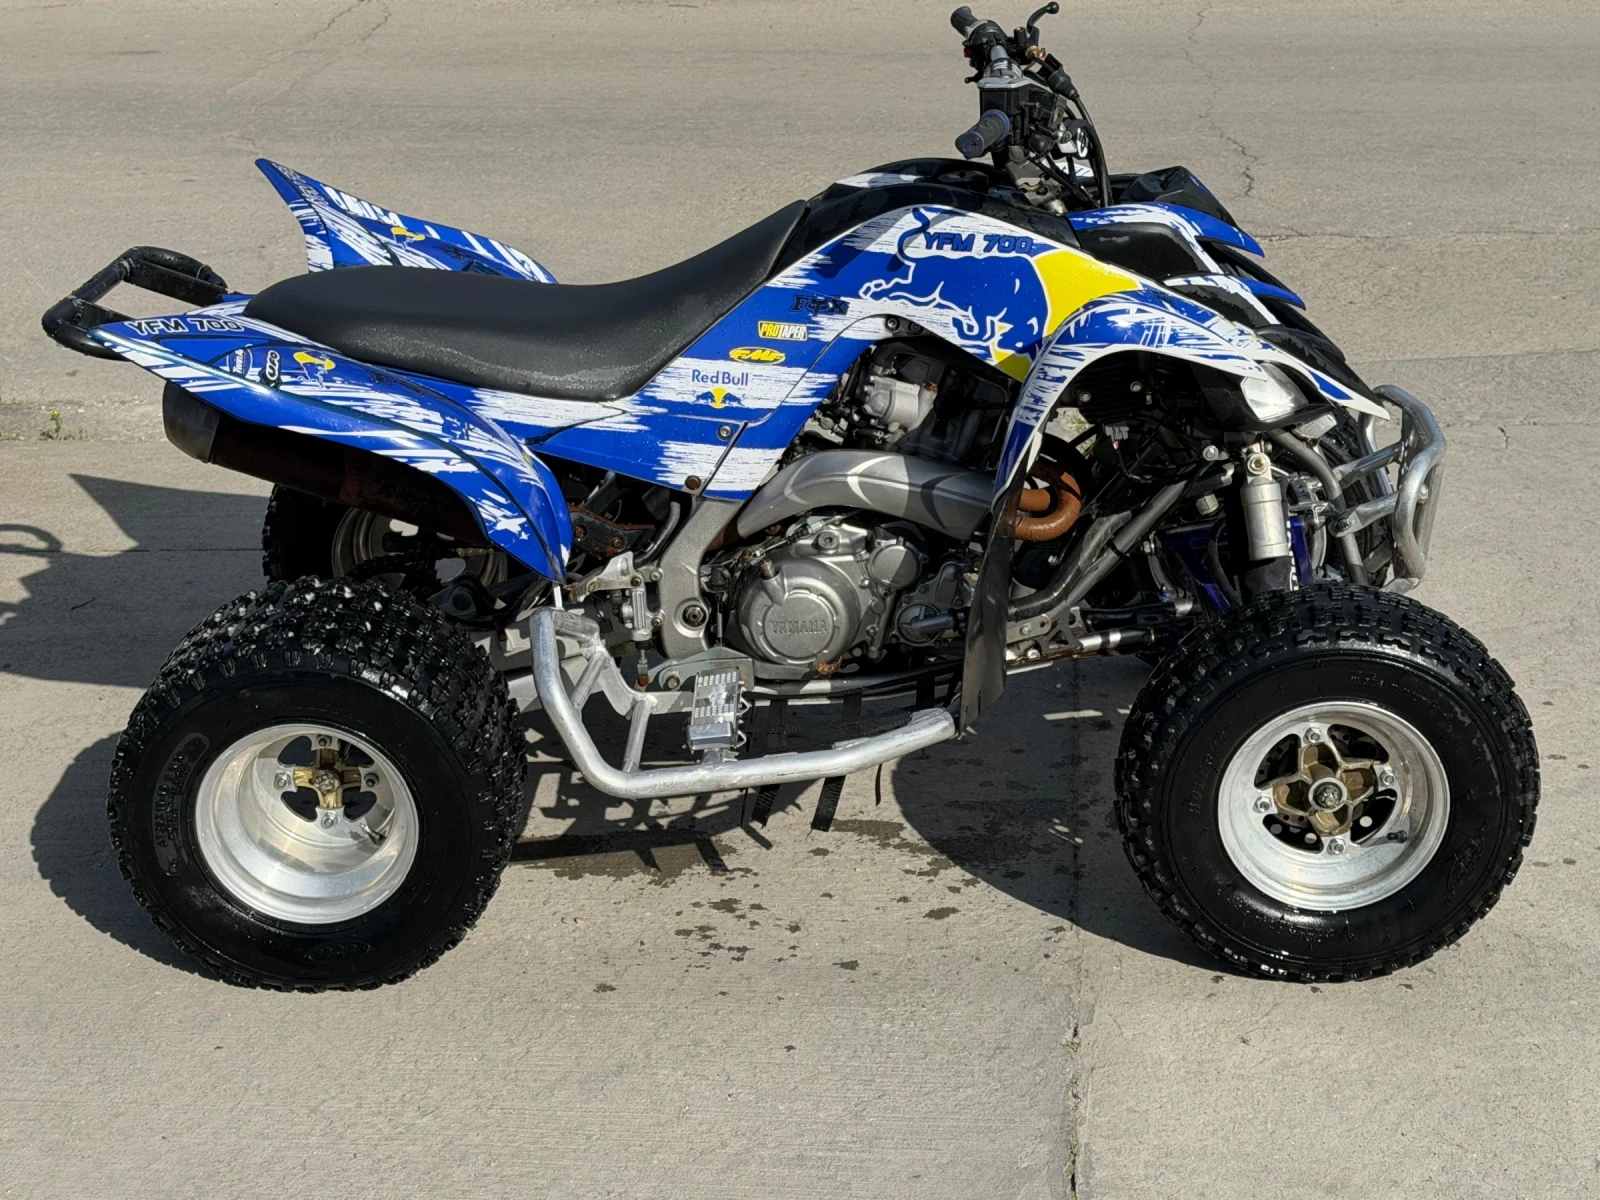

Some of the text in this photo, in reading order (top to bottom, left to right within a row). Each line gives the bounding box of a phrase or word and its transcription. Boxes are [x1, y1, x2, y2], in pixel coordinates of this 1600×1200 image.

[924, 232, 1033, 253] YFM 700
[125, 318, 245, 336] YFM 700
[731, 349, 786, 362] FMF
[266, 350, 280, 380] UFO
[692, 370, 748, 386] Red Bull
[771, 619, 828, 635] YAMAHA
